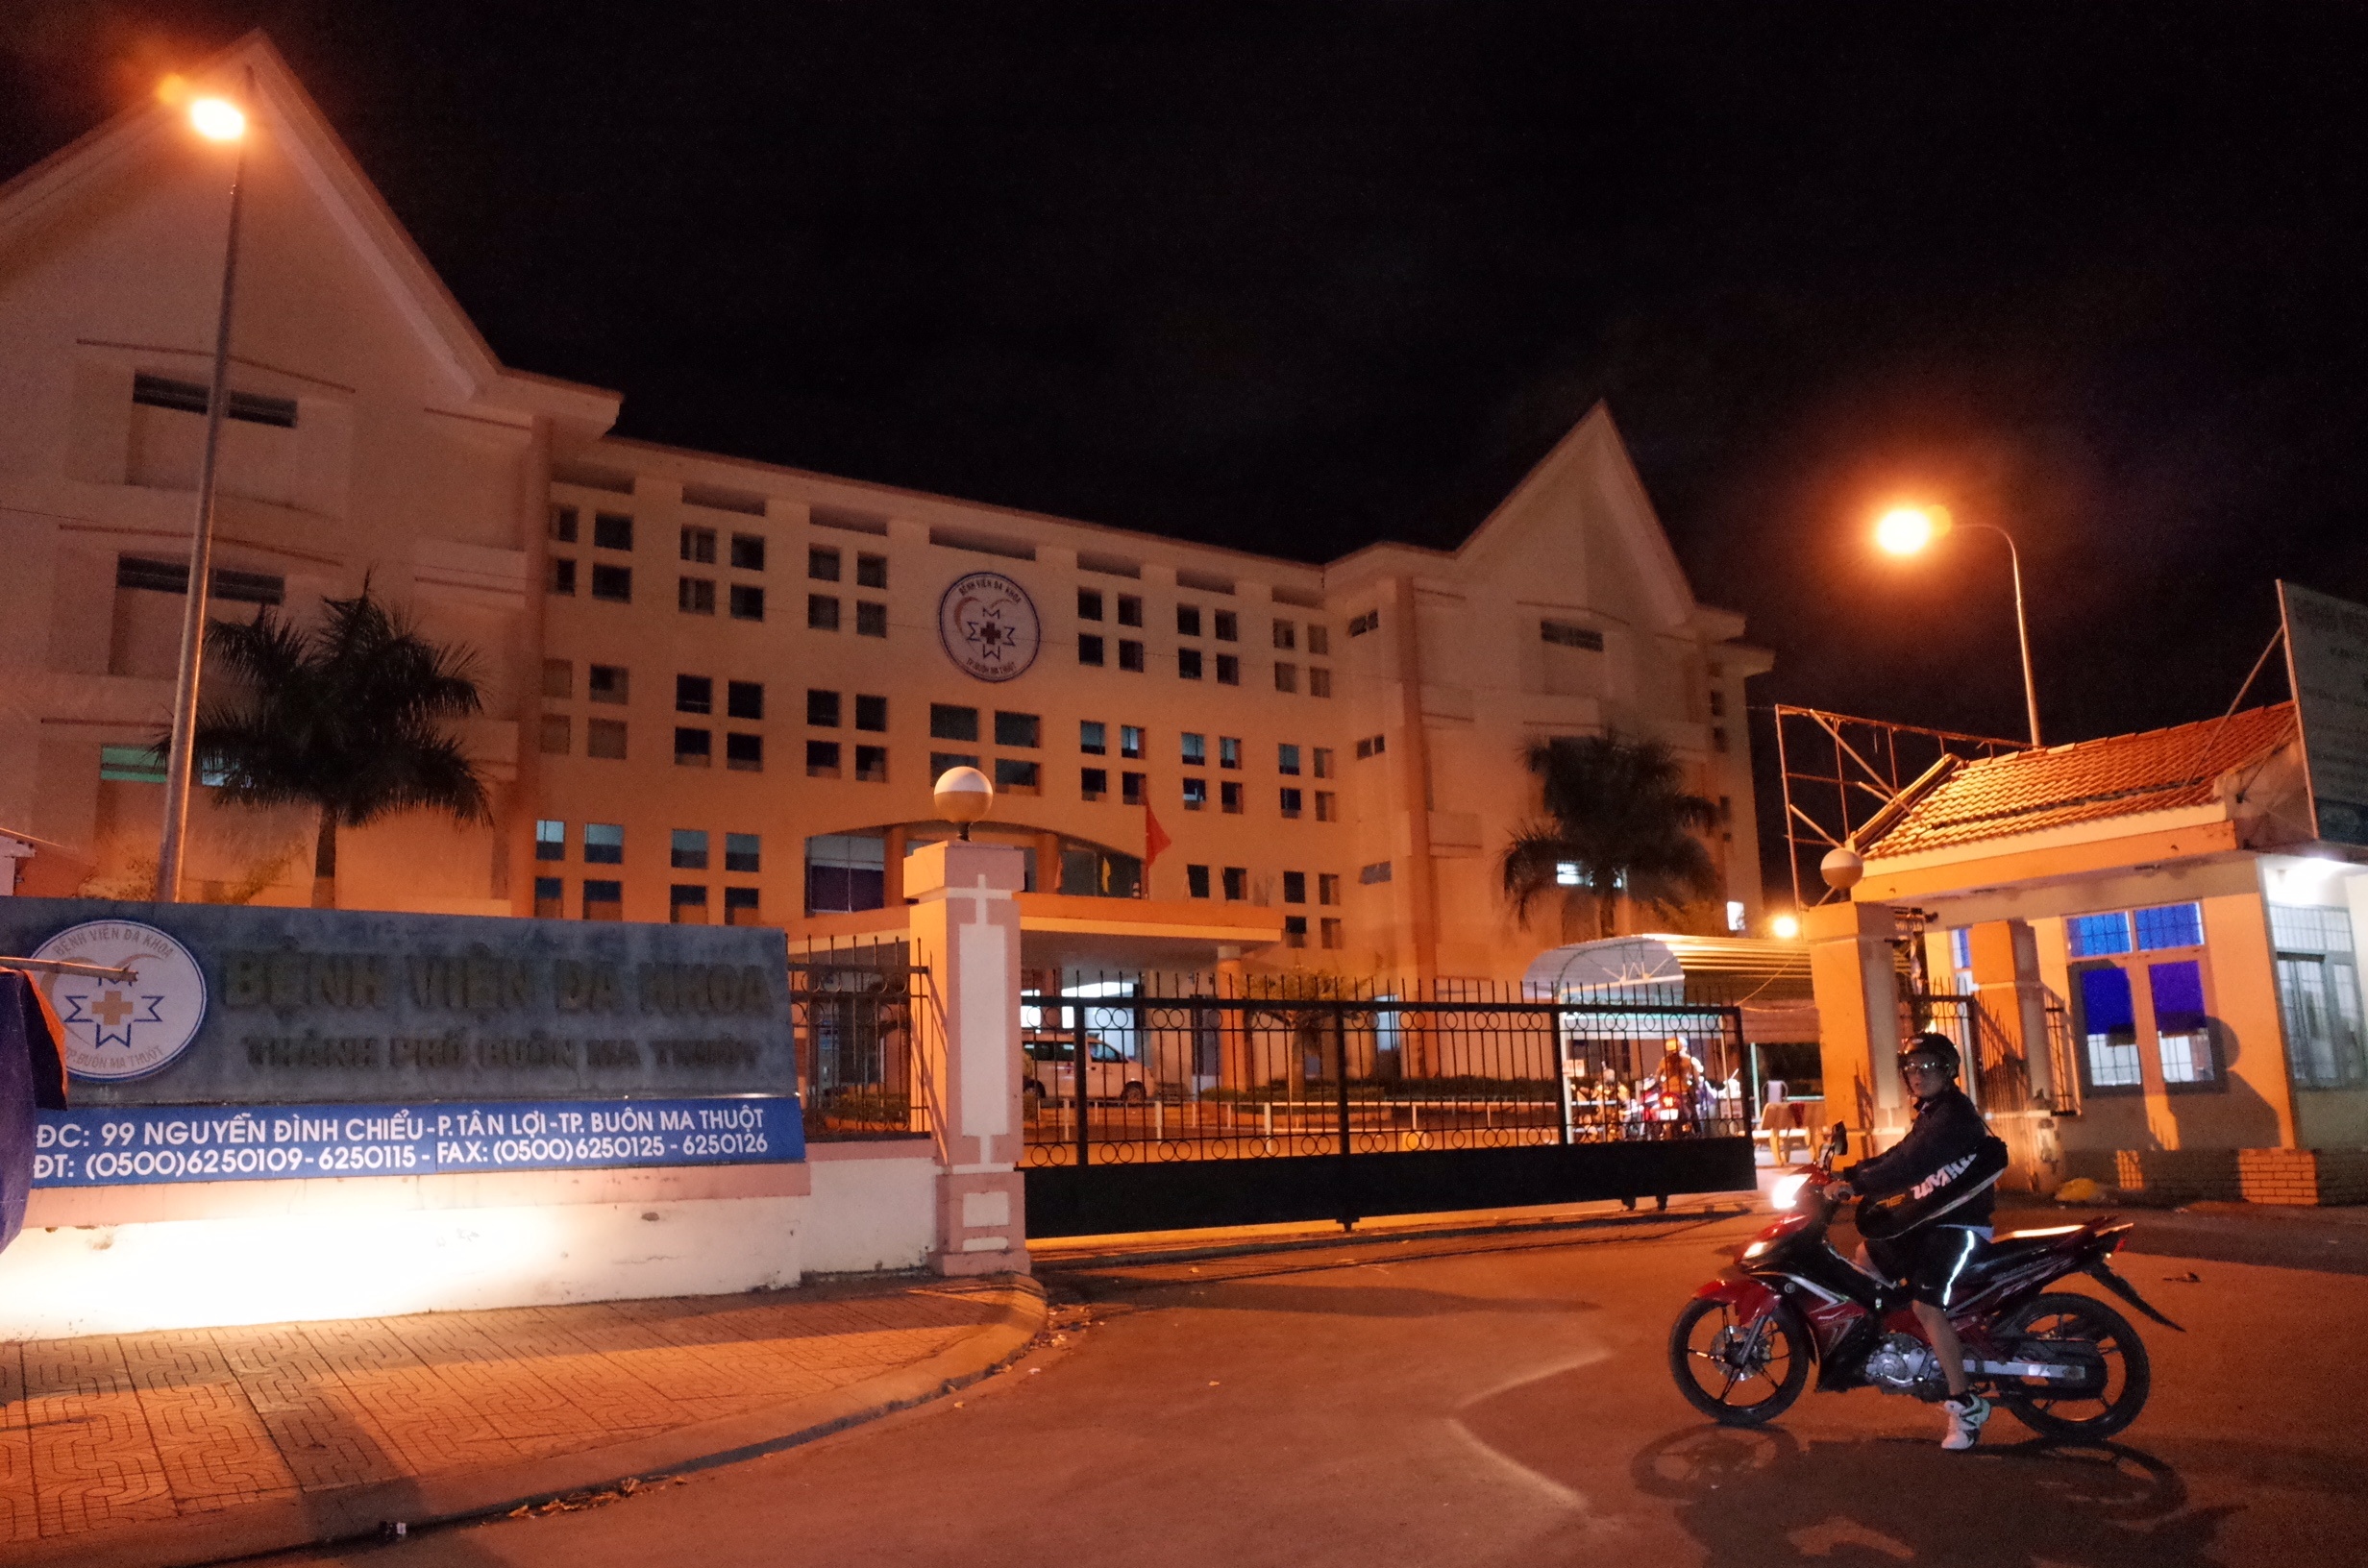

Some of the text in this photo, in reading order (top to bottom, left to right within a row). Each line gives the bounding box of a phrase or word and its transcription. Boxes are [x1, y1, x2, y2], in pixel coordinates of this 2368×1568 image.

[142, 934, 175, 959] KHOA
[638, 962, 773, 1017] KHOA
[110, 1056, 126, 1068] MA
[586, 1039, 640, 1067] MA
[37, 1123, 89, 1148] ĐC:
[101, 1122, 136, 1146] 99
[144, 1112, 265, 1145] NGUYỄN
[274, 1113, 338, 1142] ĐÌNH
[591, 1107, 654, 1133] BUÔN
[660, 1111, 695, 1131] MA
[700, 1104, 764, 1133] THUỘT
[34, 1154, 74, 1179] ĐT:
[318, 1144, 416, 1170] 6250115
[437, 1140, 488, 1164] FAX:
[683, 1132, 768, 1155] 6250126
